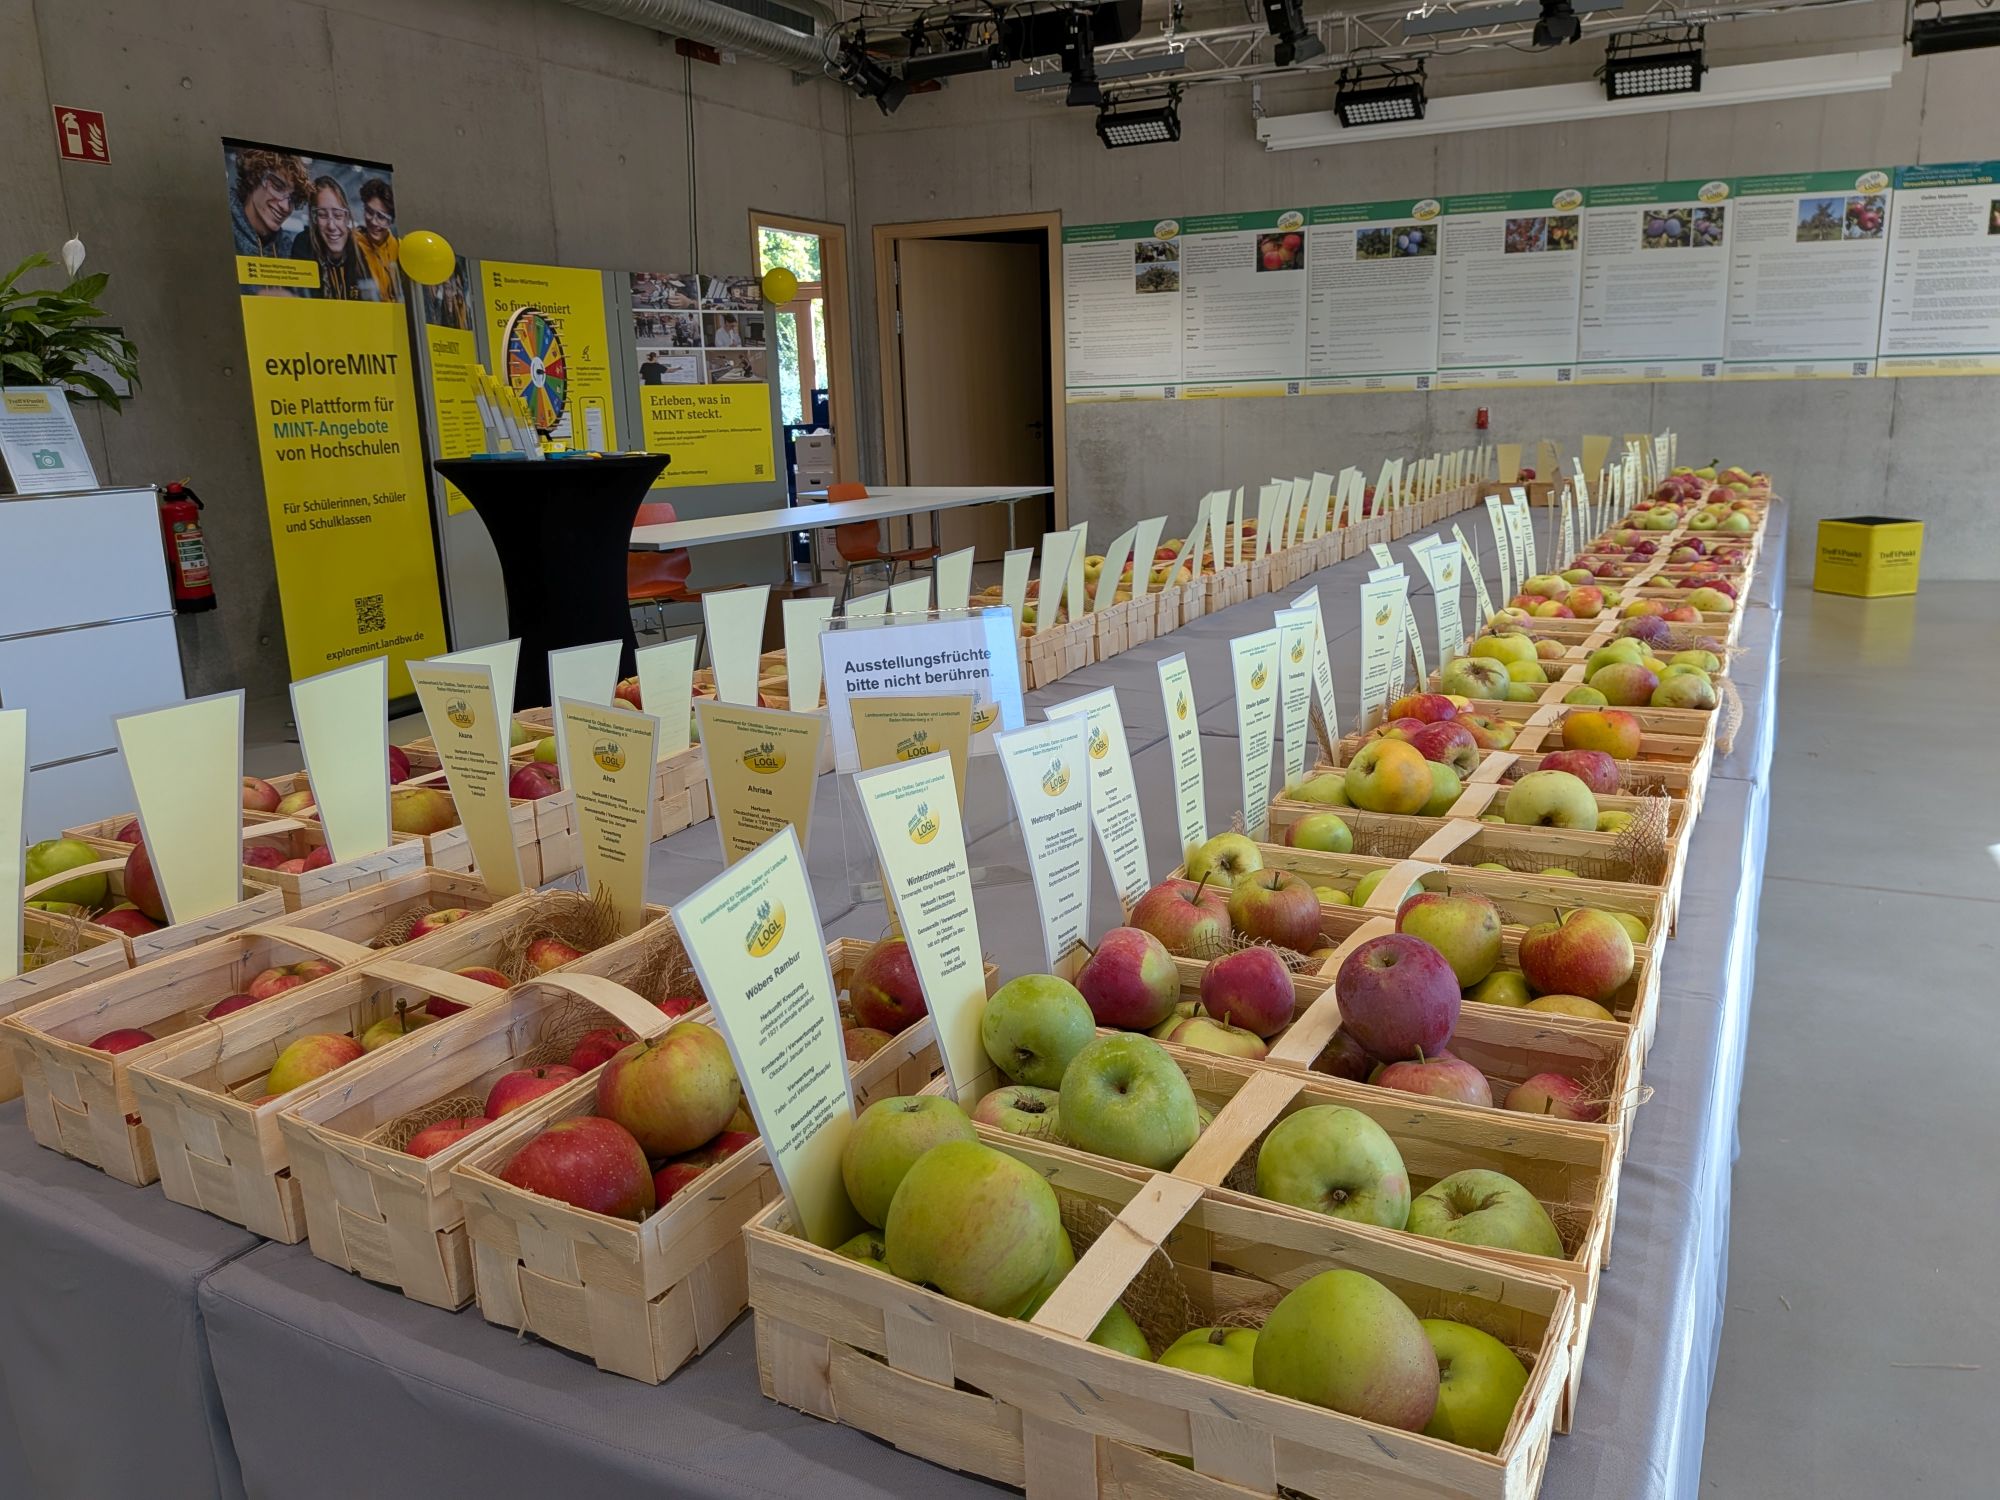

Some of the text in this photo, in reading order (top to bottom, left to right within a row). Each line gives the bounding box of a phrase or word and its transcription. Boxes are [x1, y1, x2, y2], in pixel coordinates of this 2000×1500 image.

[494, 299, 508, 312] So
[265, 352, 398, 382] exploreMINT
[270, 396, 394, 416] Die Plattform für
[650, 394, 731, 407] Erleben, was in
[652, 408, 722, 420] MINT steckt.
[273, 420, 389, 440] MINT-Angebote
[276, 439, 400, 462] von Hochschulen
[283, 492, 406, 514] Für Schülerinnen, Schüler
[286, 514, 372, 533] und Schulklassen
[326, 632, 424, 661] exploremint.landbw.de
[844, 648, 992, 674] Ausstellungsfrüchte
[846, 667, 994, 692] bitte nicht berühren.
[454, 714, 471, 722] LOGL
[907, 746, 932, 758] LOGL
[1092, 740, 1106, 754] LOGL
[601, 756, 620, 766] LOGL
[754, 758, 778, 766] LOGL
[602, 774, 616, 784] Ahra
[748, 784, 773, 796] Ahrista
[750, 805, 771, 814] Herkunft
[916, 819, 936, 836] LOGL
[758, 920, 782, 948] LOGL
[745, 952, 801, 1000] Wöbers Rambur
[782, 982, 804, 1003] Kreuzung
[788, 1066, 815, 1092] Verwertung
[788, 1092, 798, 1104] und
[790, 1096, 828, 1132] Besonderheiten
